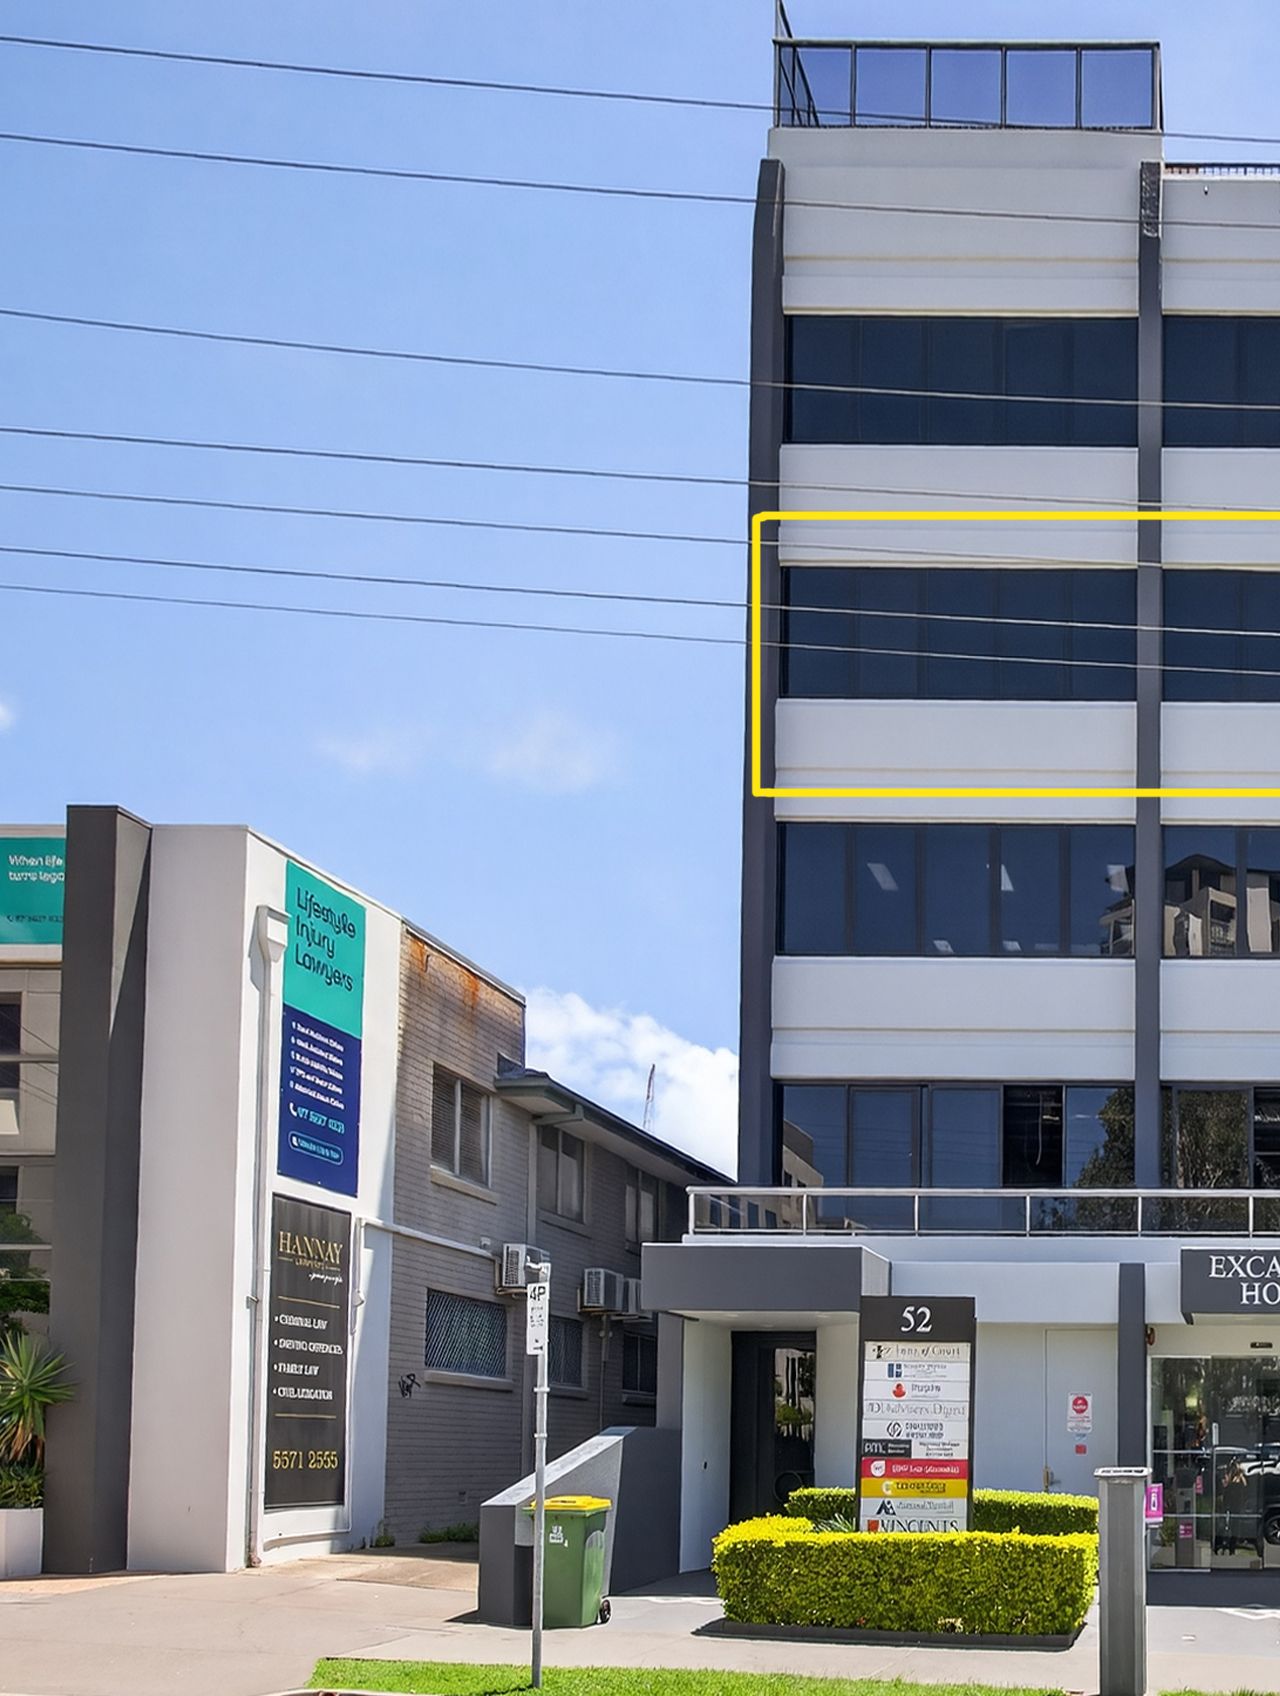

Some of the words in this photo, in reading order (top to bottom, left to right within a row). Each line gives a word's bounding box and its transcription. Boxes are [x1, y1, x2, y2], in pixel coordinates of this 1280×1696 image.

[297, 887, 356, 938] Lifestyle
[296, 914, 335, 959] Injury
[295, 943, 353, 991] Lawyers
[279, 1231, 343, 1264] HANNAY
[530, 1286, 546, 1301] 4P
[900, 1305, 932, 1332] 52
[273, 1450, 303, 1469] 5571
[308, 1451, 339, 1470] 2555
